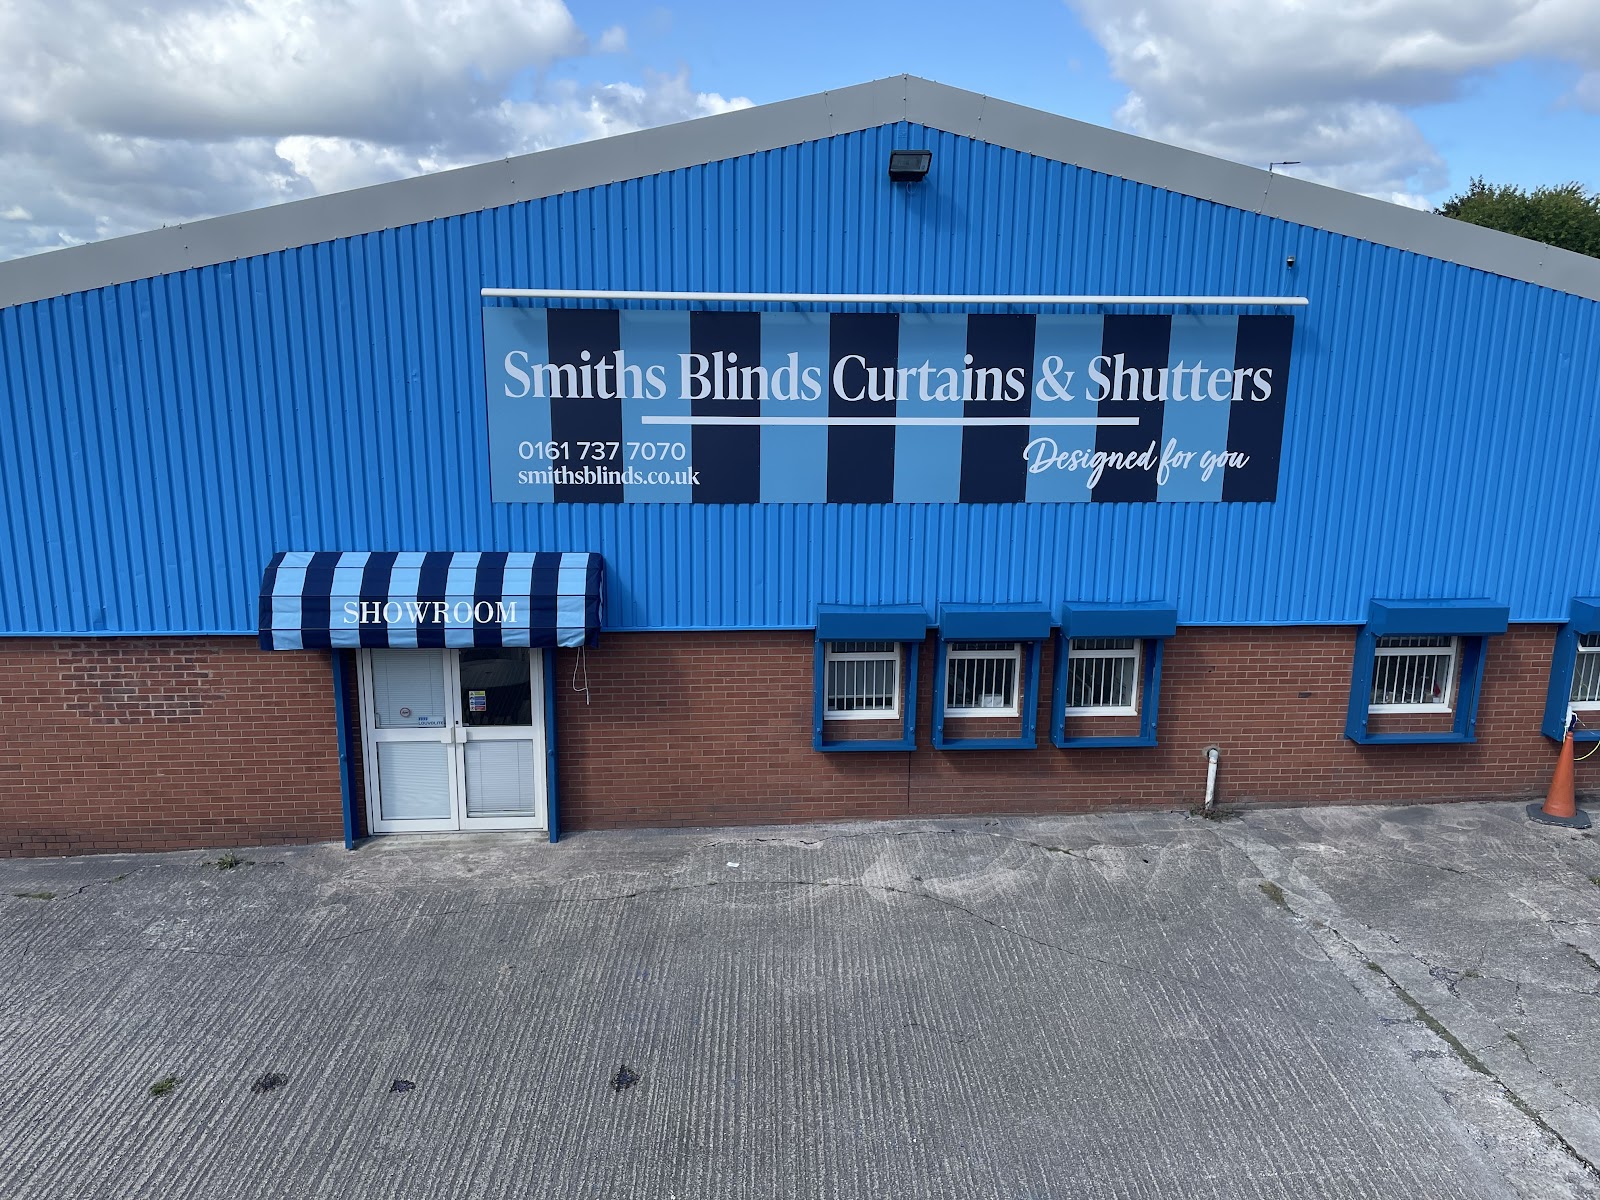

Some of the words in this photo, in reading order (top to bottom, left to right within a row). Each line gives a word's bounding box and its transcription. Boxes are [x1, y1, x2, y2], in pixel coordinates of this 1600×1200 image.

[504, 349, 667, 401] Smiths
[677, 351, 823, 402] Blinds
[832, 354, 1026, 402] Curtains
[1035, 355, 1076, 402] &
[1085, 352, 1273, 402] Shutters
[518, 441, 570, 460] 0161
[576, 441, 620, 460] 737
[627, 442, 686, 461] 7070
[1022, 437, 1157, 490] Designed
[1156, 437, 1197, 486] for
[1199, 452, 1251, 482] you
[518, 465, 701, 486] smithsblinds.co.uk
[343, 601, 518, 624] SHOWROOM
